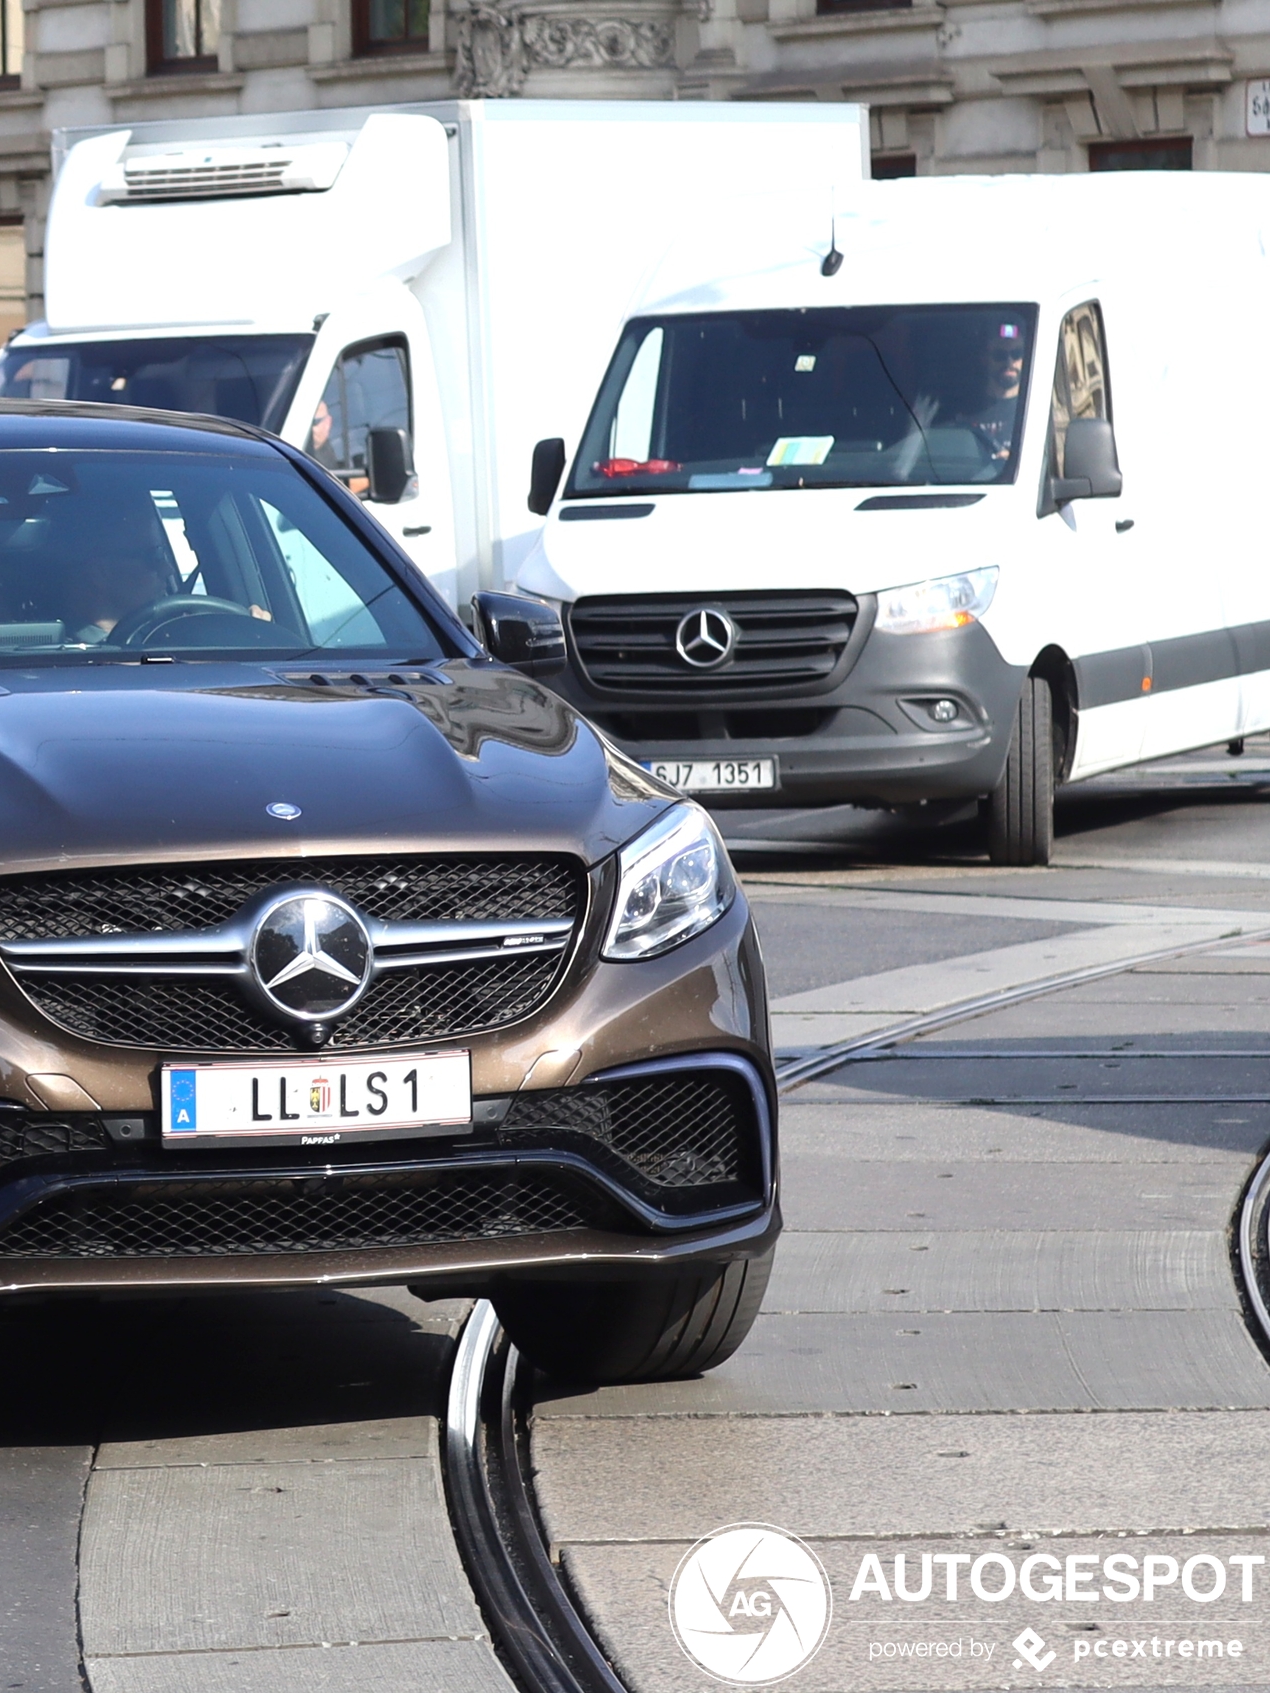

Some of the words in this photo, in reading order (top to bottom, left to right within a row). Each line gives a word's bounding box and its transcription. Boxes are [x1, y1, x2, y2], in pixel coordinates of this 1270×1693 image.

[712, 762, 763, 785] 1351
[252, 1076, 300, 1121] LL
[177, 1109, 190, 1123] A
